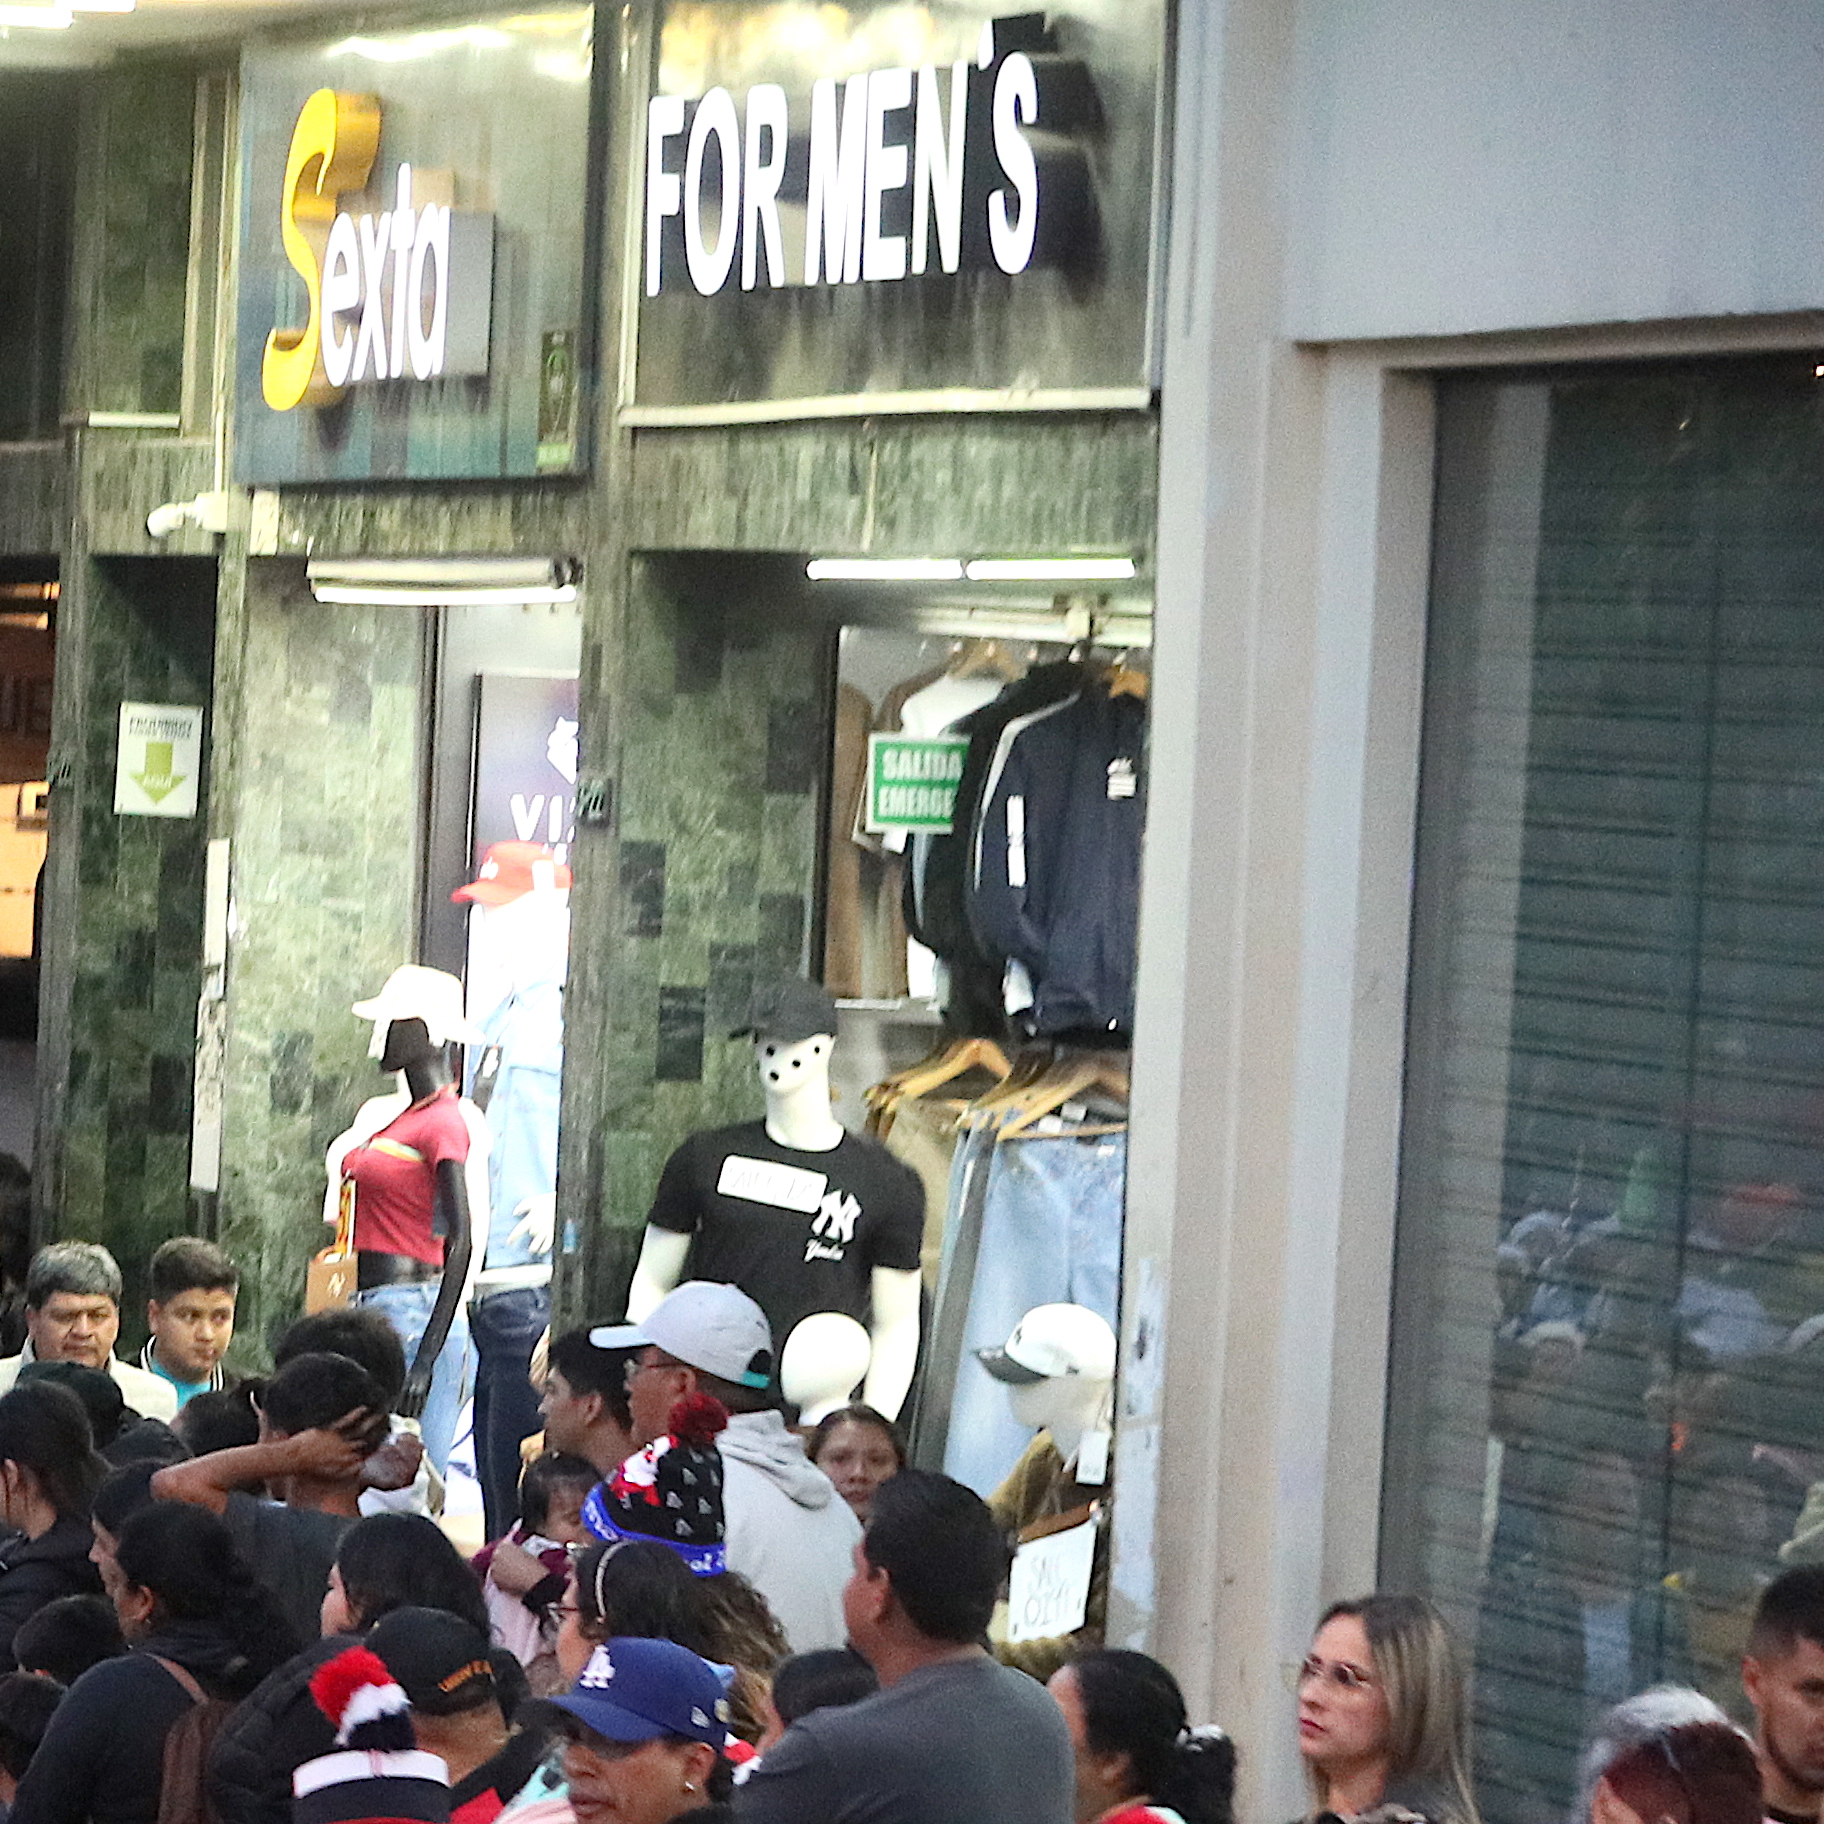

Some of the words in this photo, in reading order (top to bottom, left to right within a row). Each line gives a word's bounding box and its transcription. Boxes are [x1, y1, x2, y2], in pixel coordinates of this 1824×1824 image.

[646, 83, 789, 297] FOR
[804, 20, 1039, 286] MEN'S
[262, 87, 452, 411] Sexta
[882, 750, 964, 780] SALIDA
[509, 793, 578, 844] VI
[878, 785, 957, 818] EMERGE
[810, 1189, 863, 1243] NY
[578, 1644, 616, 1689] LA
